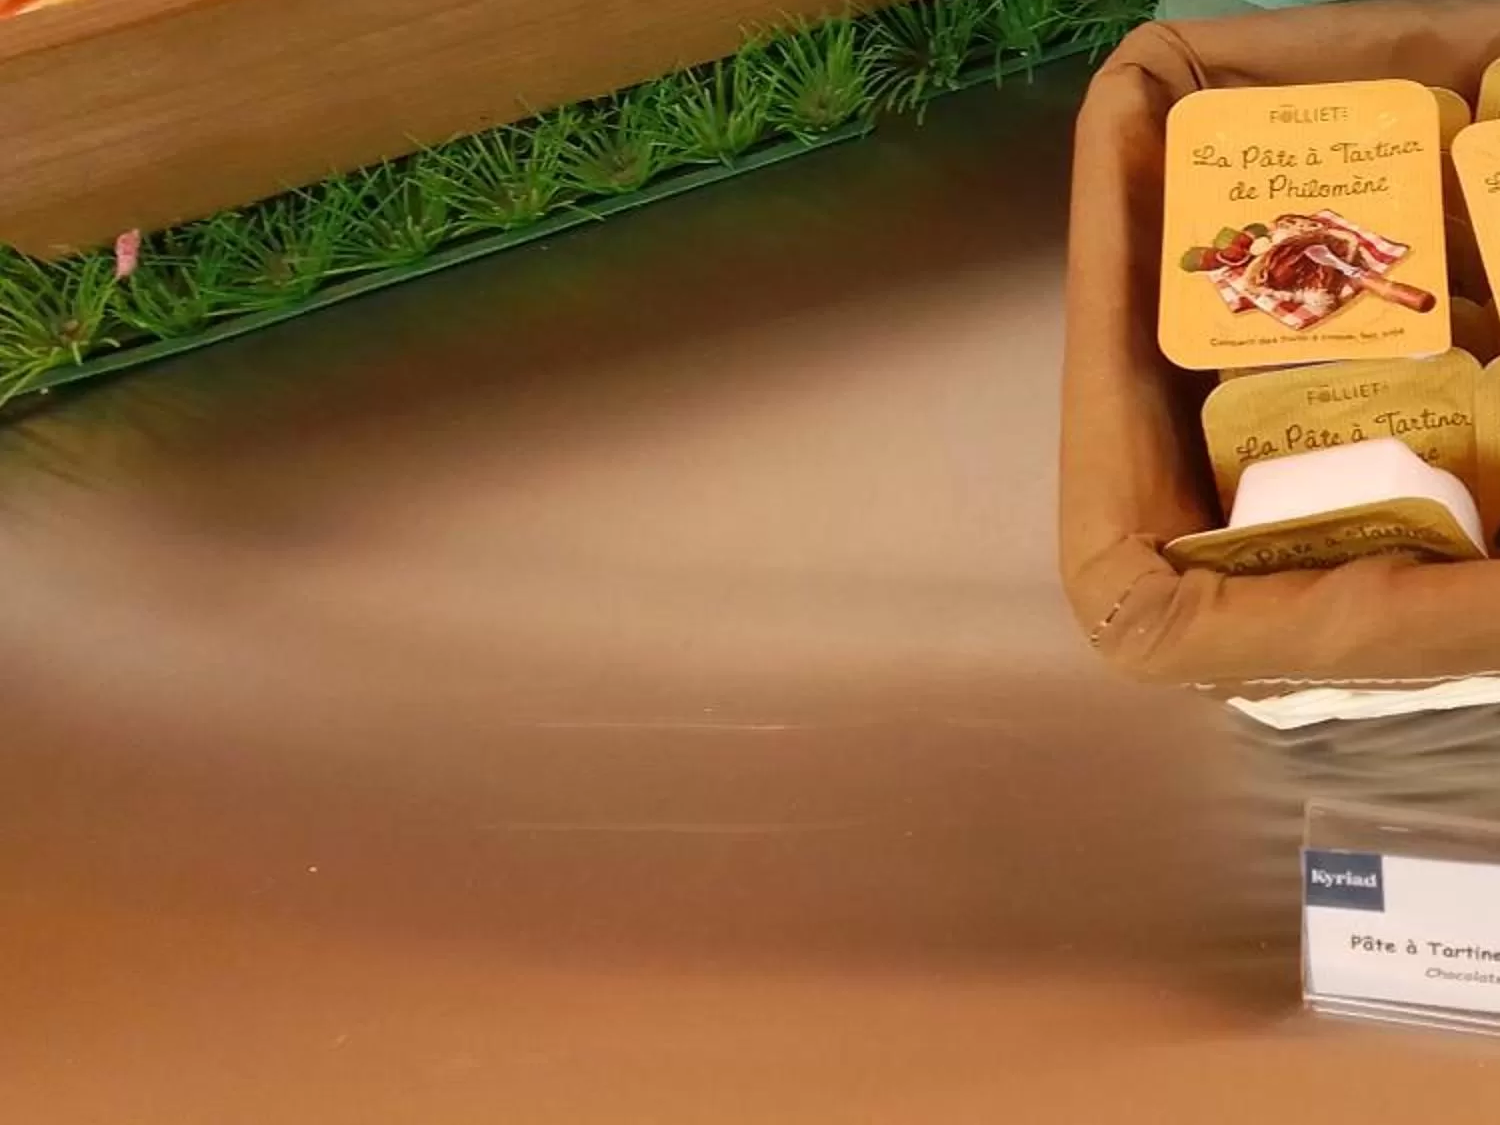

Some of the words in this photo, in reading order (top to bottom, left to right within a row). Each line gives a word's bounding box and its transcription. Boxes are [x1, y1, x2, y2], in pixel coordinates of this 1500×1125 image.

[1192, 144, 1232, 168] La
[1242, 145, 1298, 169] Pâte
[1305, 147, 1323, 166] à
[1330, 140, 1424, 164] Tartiner
[1229, 180, 1259, 202] de
[1269, 174, 1390, 200] Philomène
[1236, 436, 1279, 462] La
[1286, 424, 1344, 449] Pâte
[1375, 408, 1473, 436] Tartiner
[1311, 868, 1377, 888] Kyriad
[1351, 934, 1396, 953] Pâte
[1406, 938, 1418, 955] à
